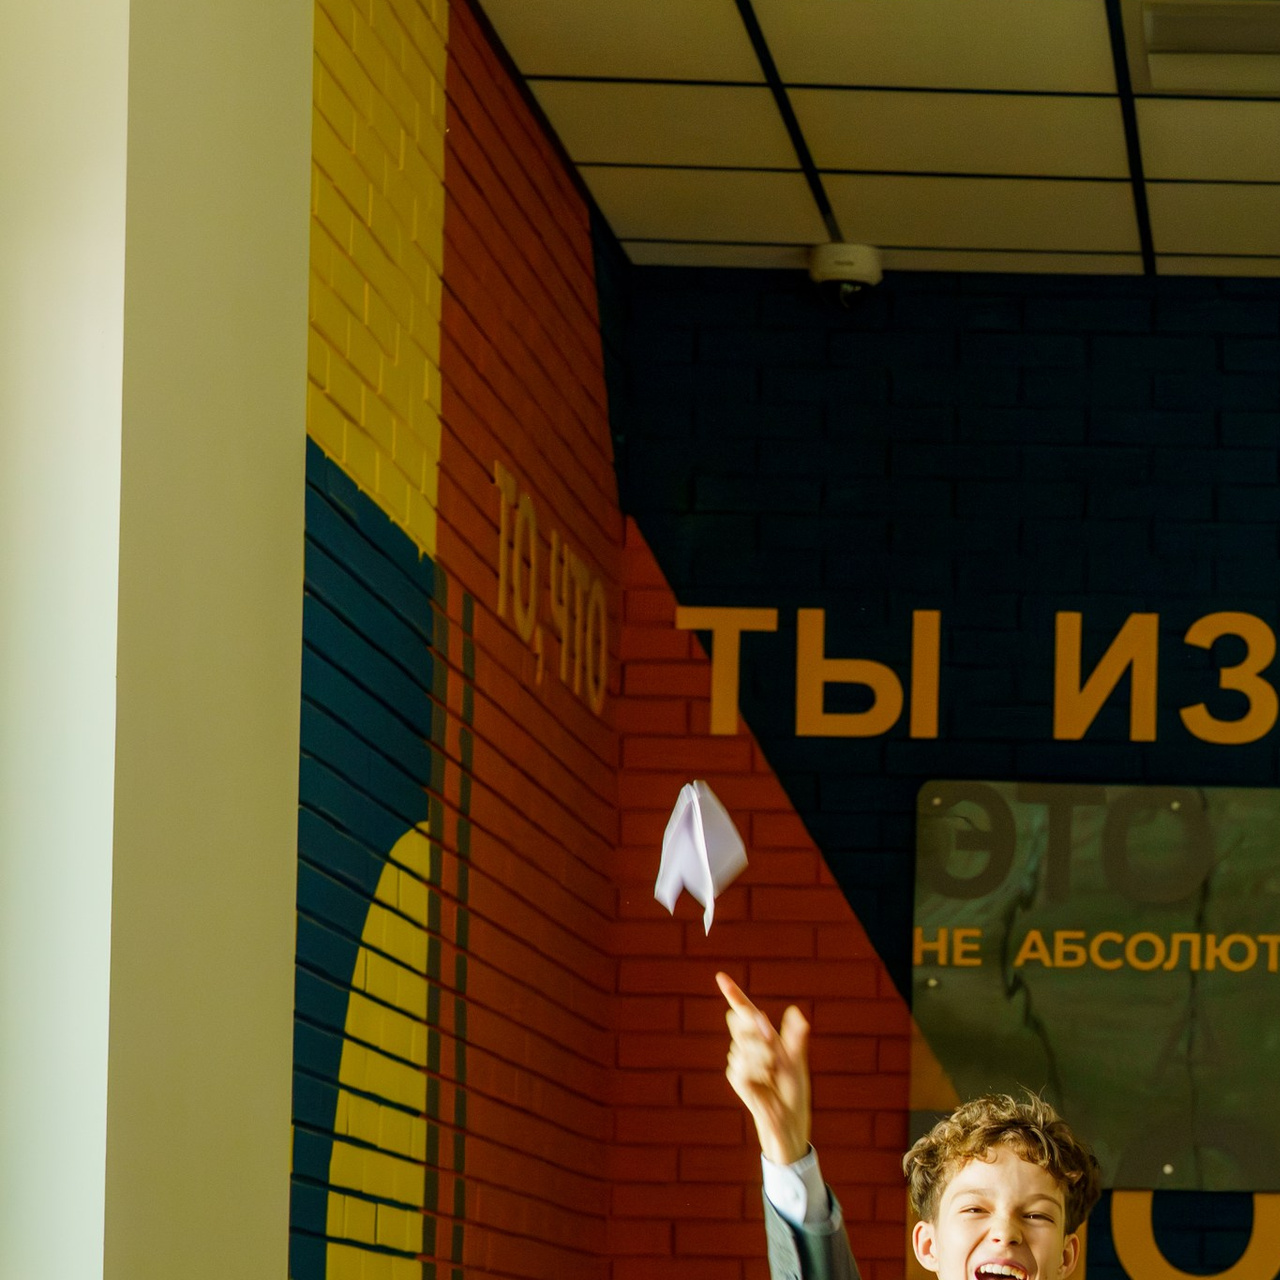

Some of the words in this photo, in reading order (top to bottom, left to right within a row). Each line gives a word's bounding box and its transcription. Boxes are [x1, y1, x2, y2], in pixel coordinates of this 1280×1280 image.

[494, 459, 544, 687] ТО,
[550, 528, 608, 717] ЧТО
[675, 605, 942, 740] ТЫ
[919, 781, 1213, 902] ЭТО
[913, 928, 983, 967] НЕ
